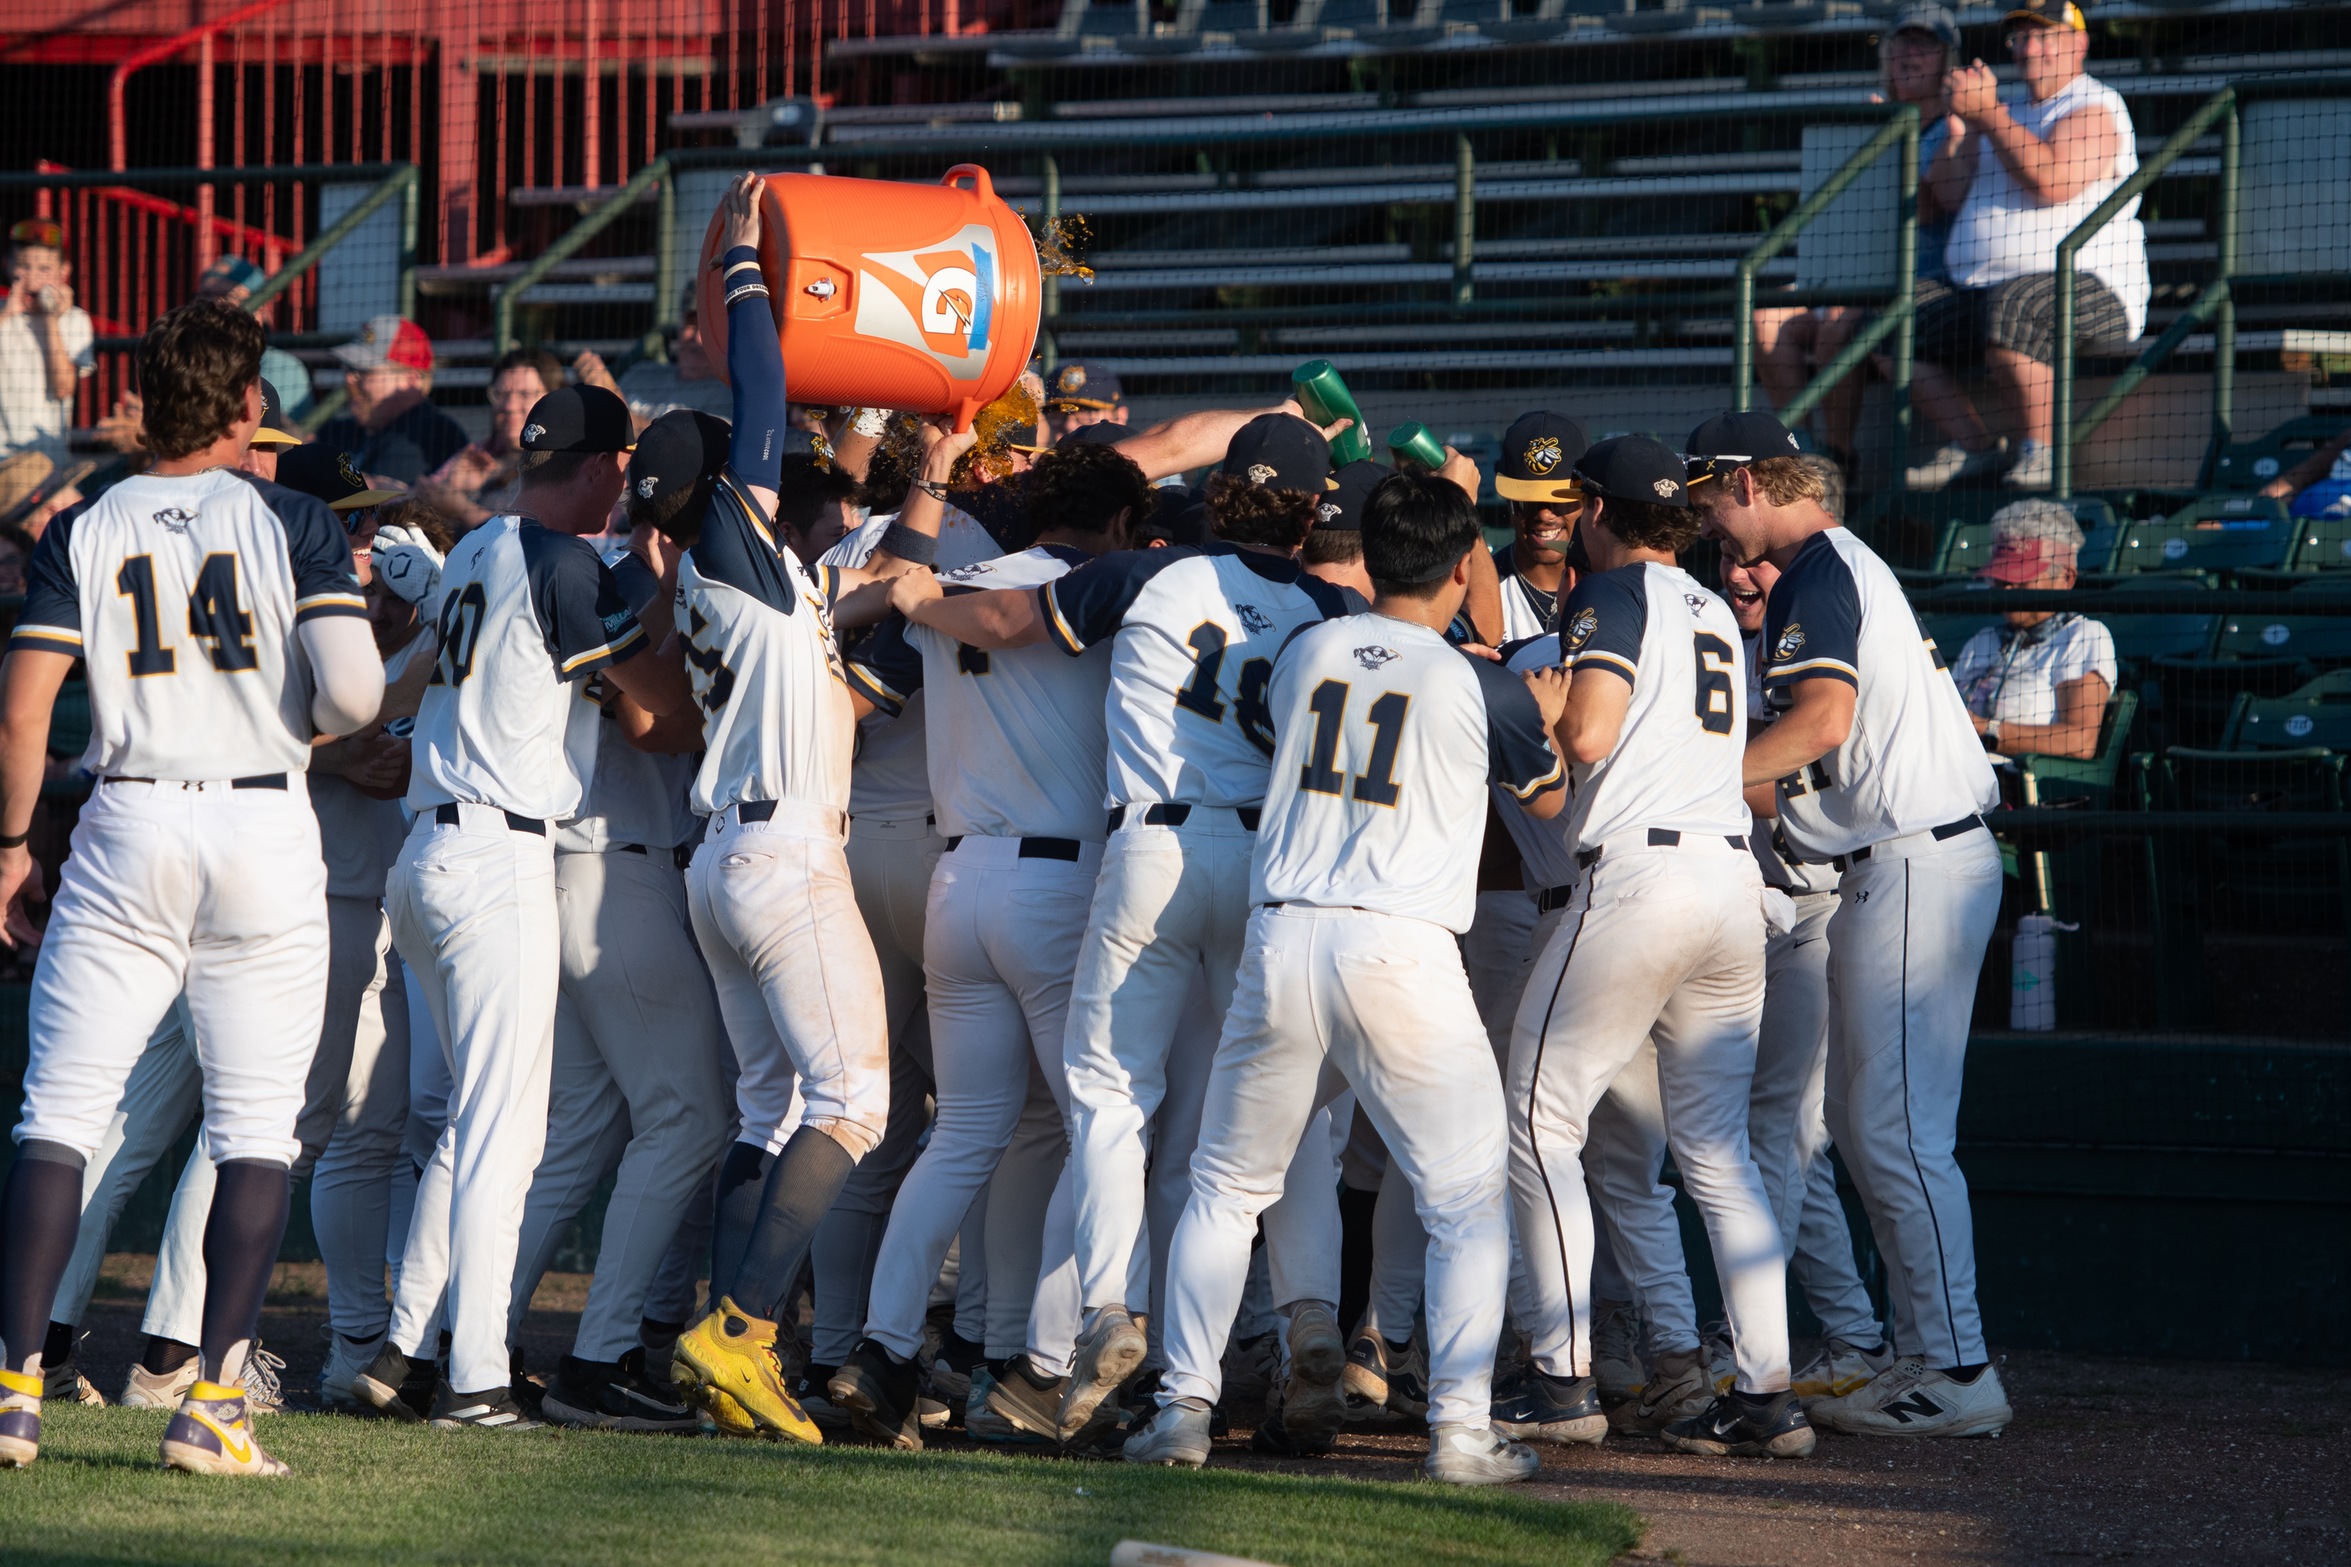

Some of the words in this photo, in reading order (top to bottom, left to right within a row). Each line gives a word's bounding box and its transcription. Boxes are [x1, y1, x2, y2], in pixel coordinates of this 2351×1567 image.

[922, 266, 978, 335] G
[115, 551, 261, 679] 14
[1693, 628, 1734, 737] 6
[1299, 676, 1413, 810] 11
